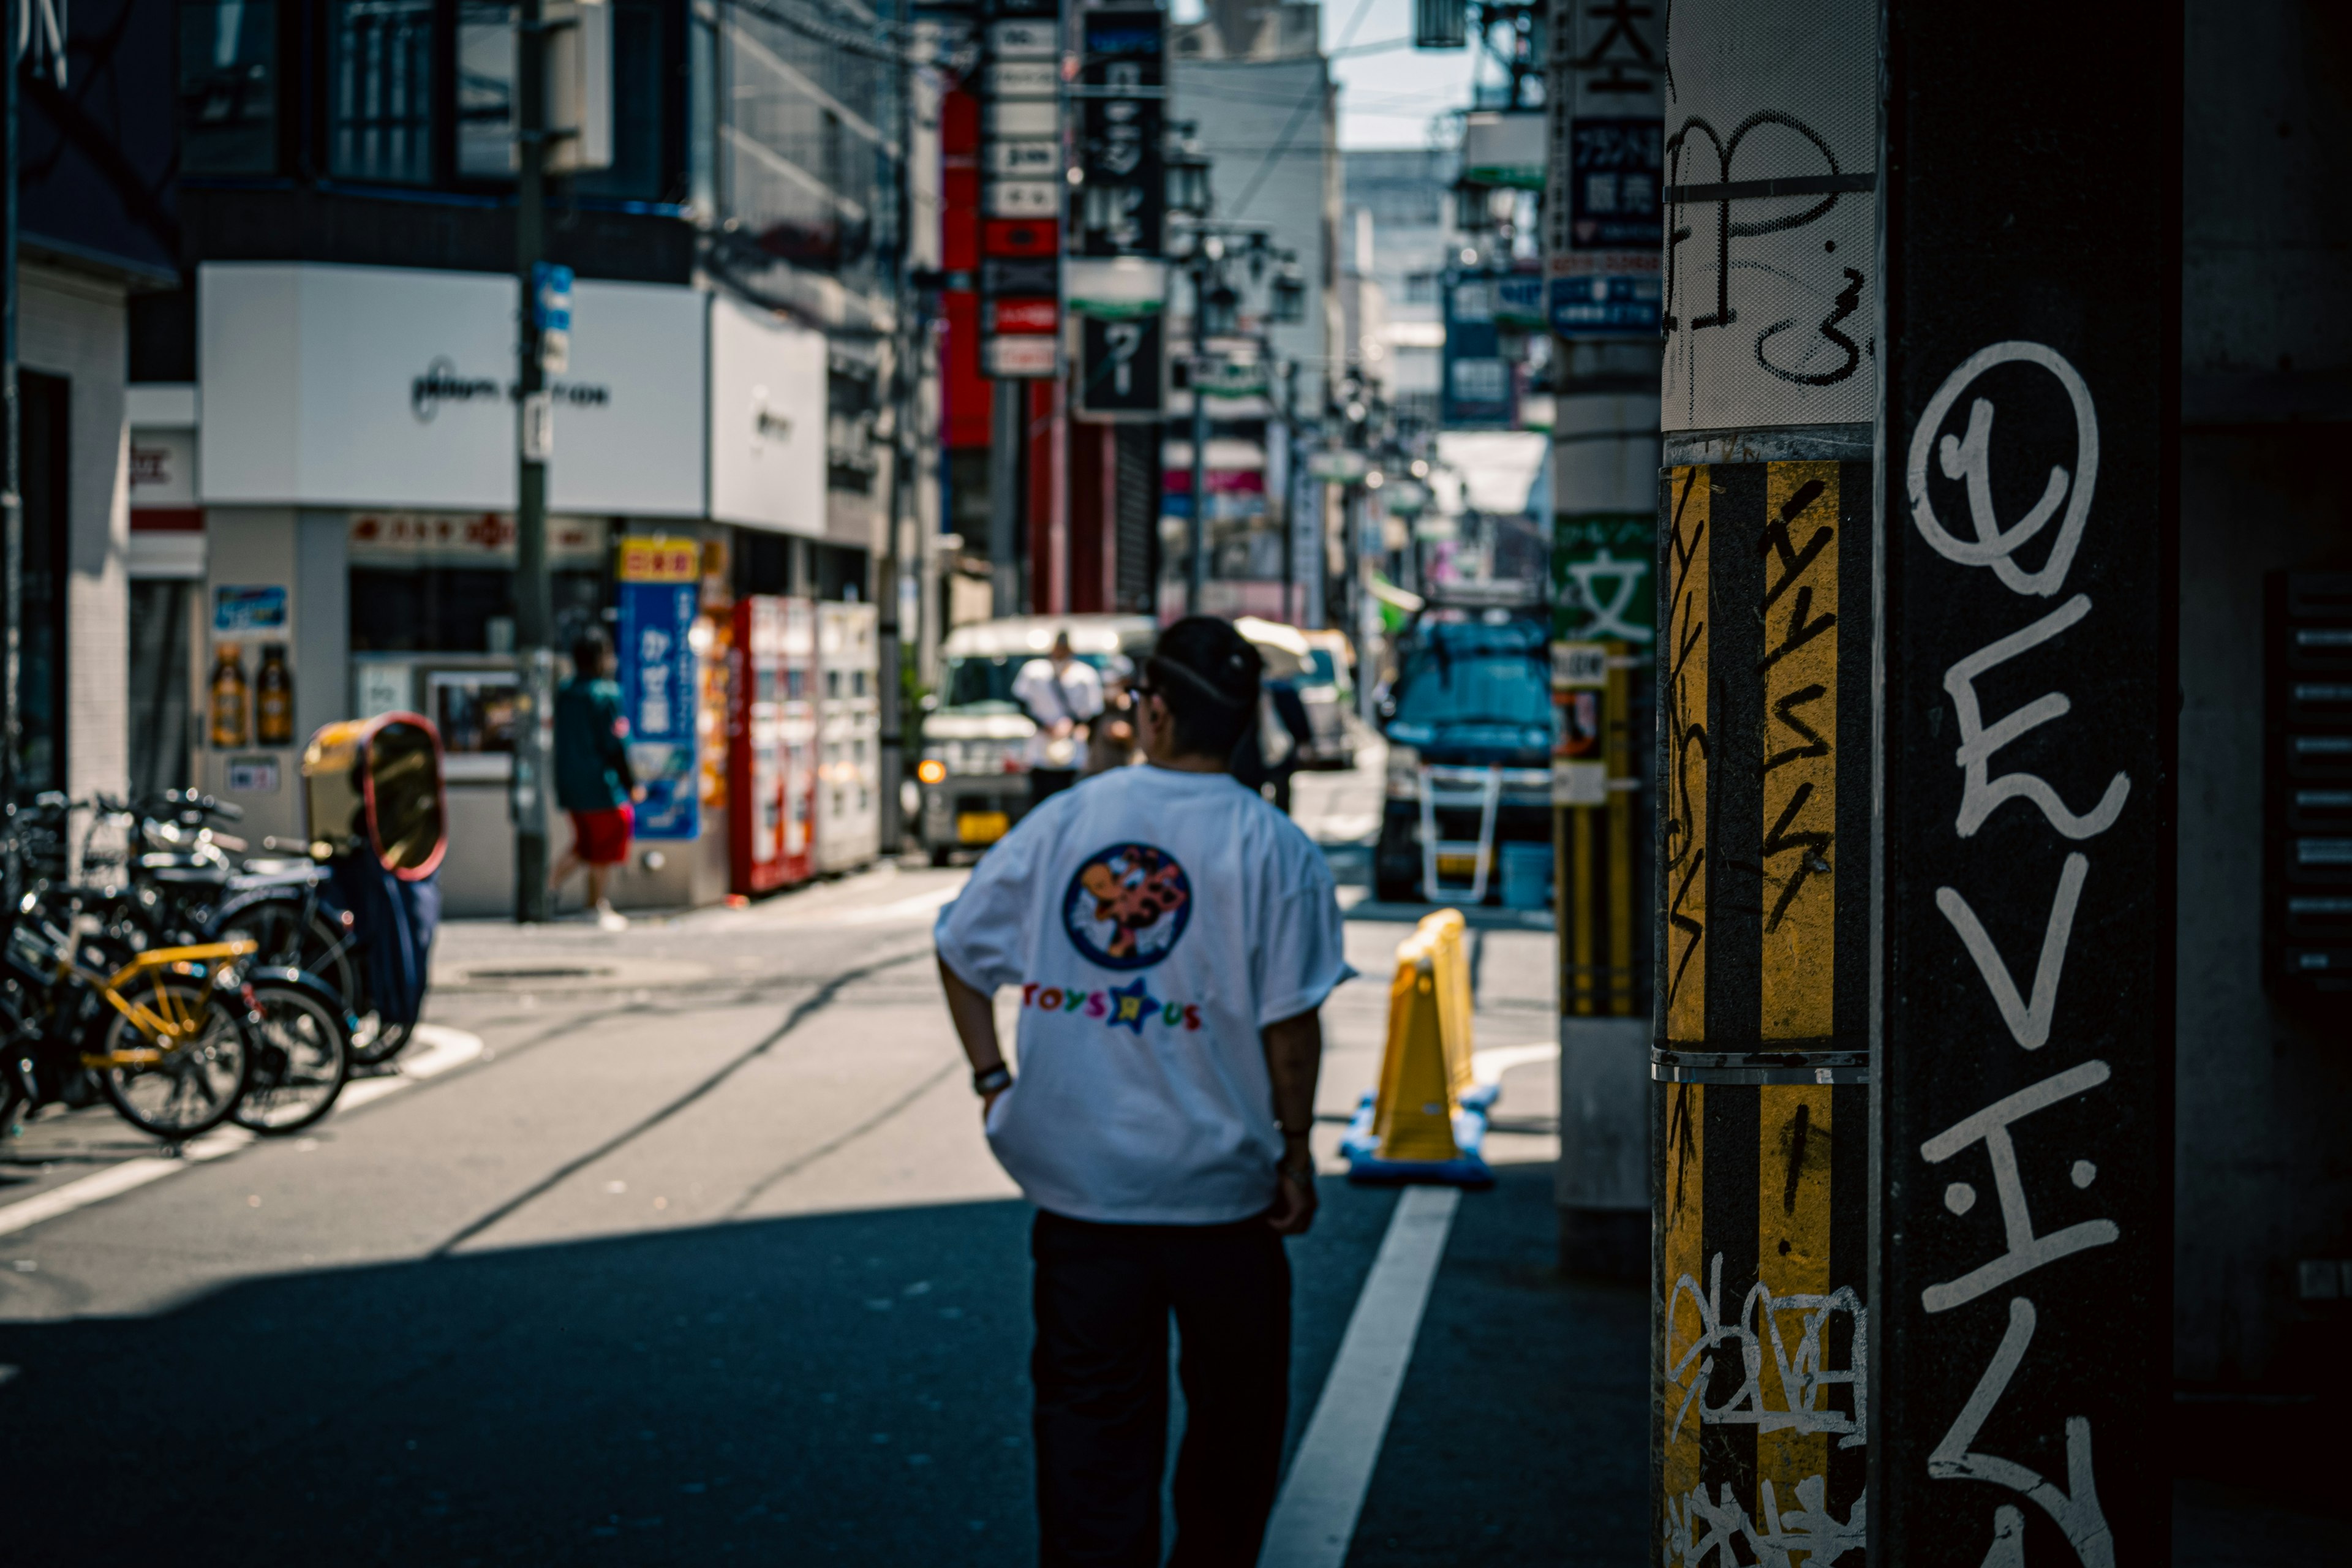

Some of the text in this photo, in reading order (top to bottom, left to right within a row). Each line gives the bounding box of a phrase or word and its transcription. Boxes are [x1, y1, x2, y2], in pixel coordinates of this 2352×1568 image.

[1565, 547, 1654, 642] 文
[1023, 982, 1107, 1018] TOYS
[1163, 1002, 1202, 1031] US
